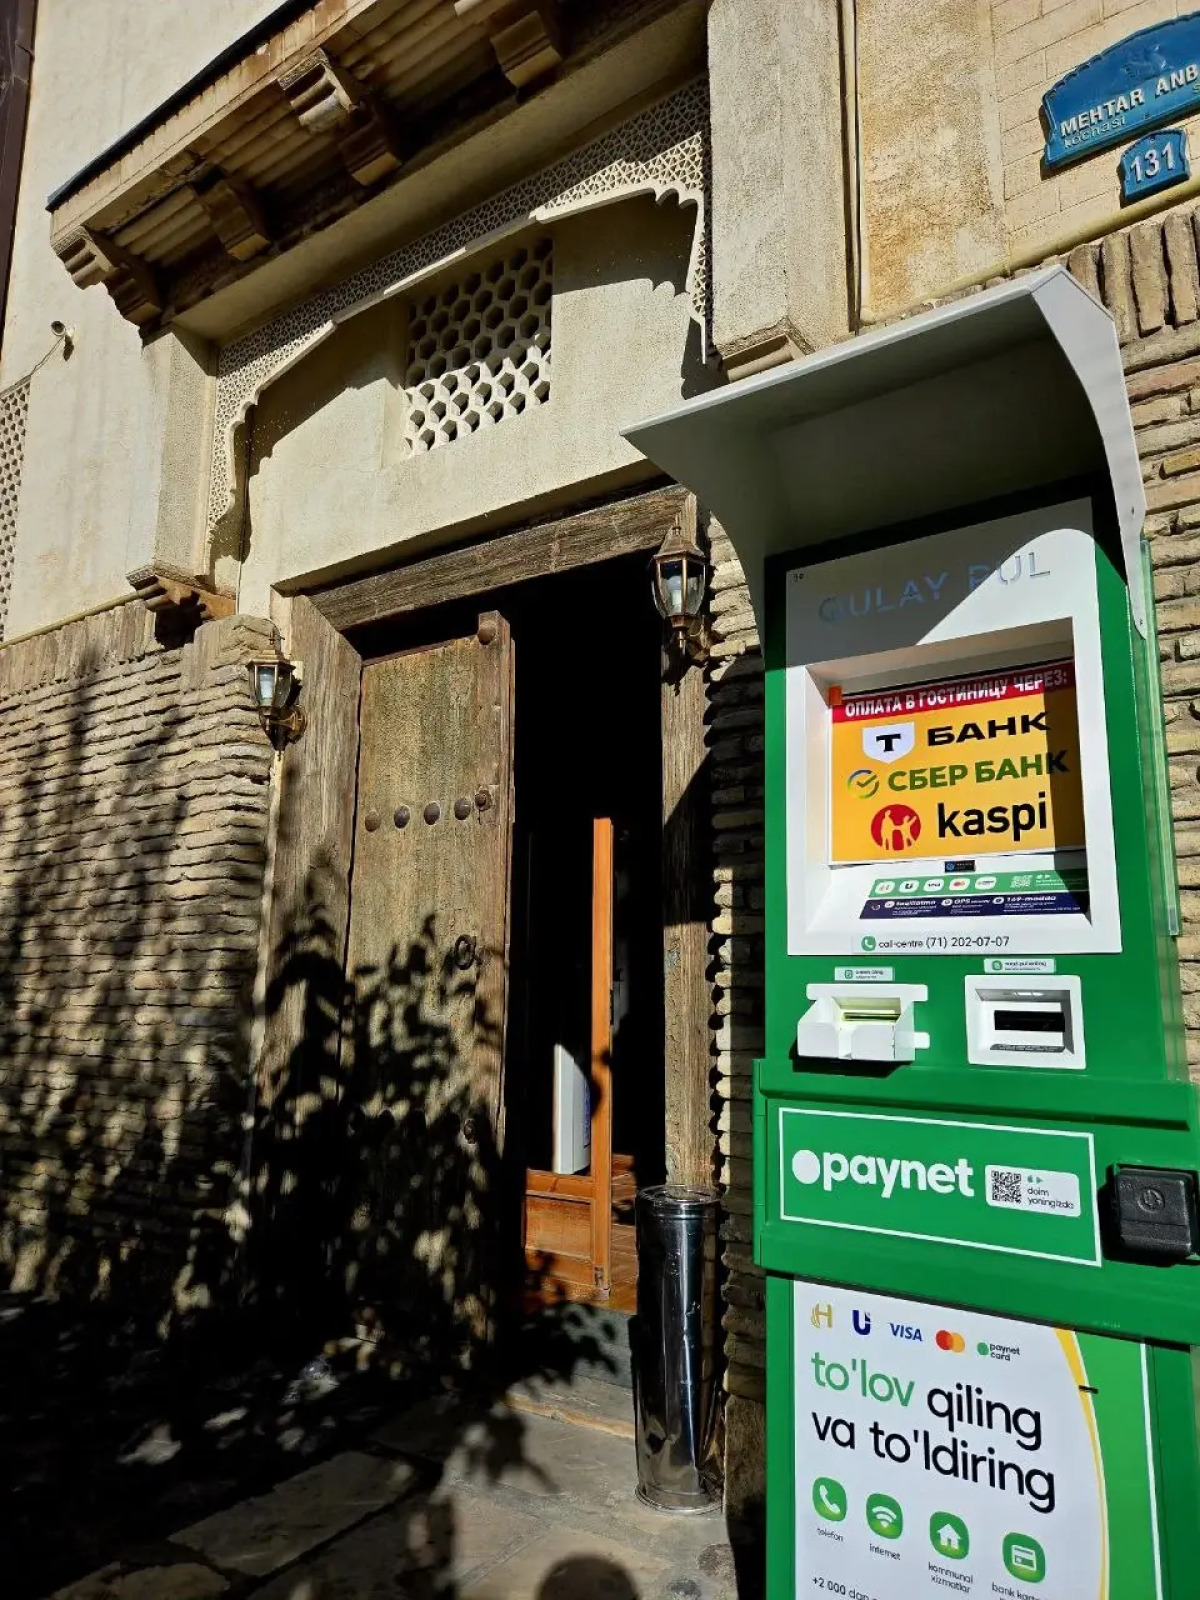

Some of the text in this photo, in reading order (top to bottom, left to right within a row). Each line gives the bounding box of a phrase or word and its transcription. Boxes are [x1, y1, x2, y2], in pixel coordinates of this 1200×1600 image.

[1060, 88, 1145, 137] MEHTAR
[1130, 141, 1176, 182] 131
[968, 551, 1051, 592] PUL
[844, 669, 1068, 718] ОПЛАТА В ГОСТИНИЦУ ЧЕРЕЗ:
[927, 711, 1052, 747] БАНК
[888, 750, 1071, 792] СБЕР БАНК
[937, 791, 1047, 842] kaspi
[925, 936, 948, 949] (71)
[951, 936, 1010, 947] 202-07-07
[822, 1151, 975, 1198] paynet
[1026, 1187, 1050, 1197] doim
[889, 1322, 923, 1342] VISA
[989, 1343, 1020, 1356] paynet
[990, 1352, 1011, 1362] card
[810, 1351, 1042, 1451] to'lov qiling
[811, 1411, 1056, 1514] va to'ldiring
[816, 1527, 844, 1542] telefon
[869, 1543, 901, 1560] internet
[812, 1576, 825, 1588] +2
[827, 1580, 846, 1596] 000
[928, 1561, 973, 1584] kommunal
[931, 1574, 971, 1594] xizmatlar
[991, 1581, 1015, 1598] bank
